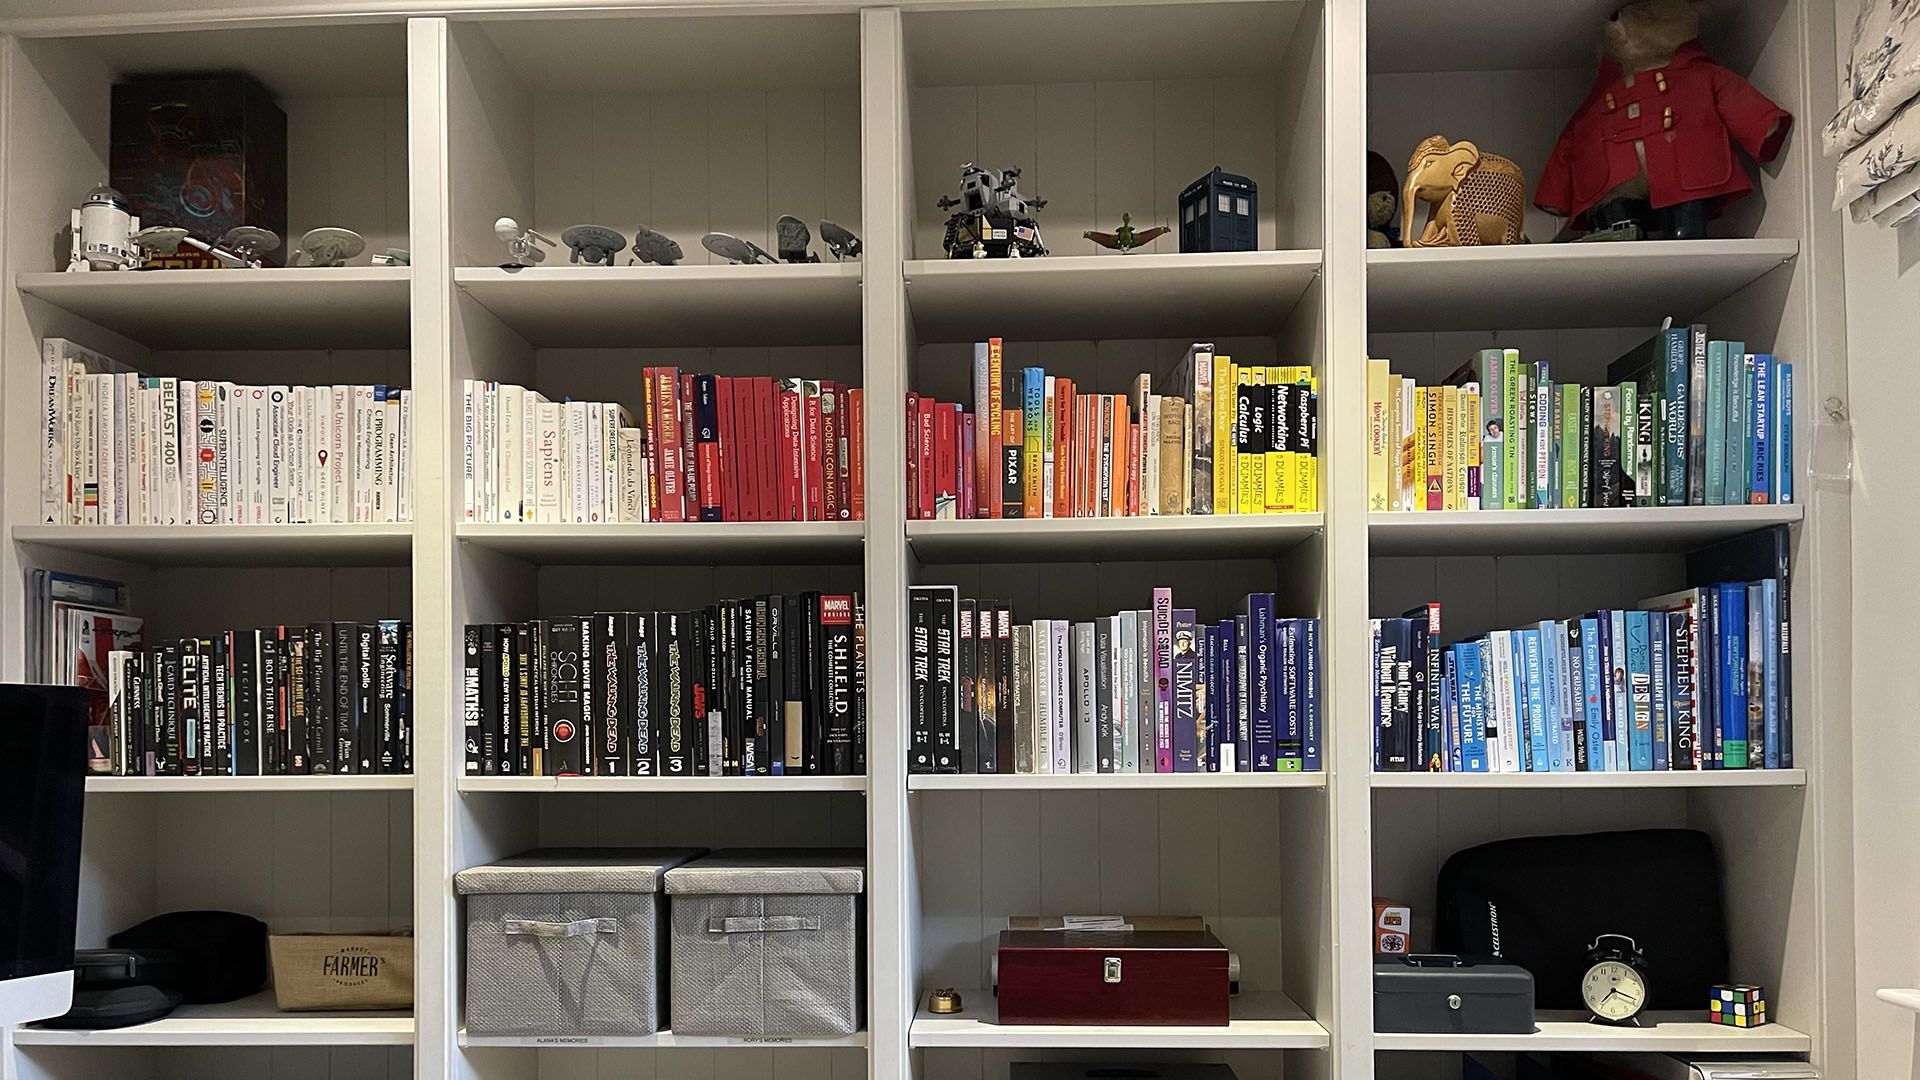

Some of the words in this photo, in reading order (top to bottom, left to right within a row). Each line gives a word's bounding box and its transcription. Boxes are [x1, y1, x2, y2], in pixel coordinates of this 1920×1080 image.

[163, 382, 174, 437] BELFAST
[1239, 396, 1250, 443] Calculus
[1254, 407, 1264, 433] Logic
[1275, 385, 1289, 450] Networking
[1298, 390, 1310, 436] Raspberry
[1639, 403, 1650, 442] KING
[1757, 403, 1765, 439] STARTUP
[335, 412, 343, 448] Unicorn
[1301, 438, 1310, 448] Pi
[165, 441, 175, 465] 400
[219, 429, 227, 507] SUPERINTELLIGENCE
[334, 452, 343, 484] Project
[539, 431, 556, 486] Sapiens
[1008, 450, 1017, 484] PIXAR
[628, 479, 634, 488] da
[1240, 462, 1249, 504] DUMMIES
[1253, 462, 1262, 505] DUMMIES
[1275, 460, 1284, 503] DUMMIES
[1299, 461, 1309, 503] DUMMIES
[824, 600, 849, 610] MARVEL
[855, 604, 864, 629] THE
[1157, 598, 1169, 635] SUICIDE
[1430, 608, 1440, 632] MARVEL
[961, 611, 972, 638] MARVEL
[980, 611, 992, 638] MARVEL
[998, 611, 1009, 638] MARVEL
[1258, 608, 1266, 643] Lishman's
[339, 630, 347, 654] UNTIL
[360, 633, 370, 660] Digital
[606, 641, 617, 667] THE
[637, 642, 648, 668] THE
[669, 640, 680, 666] THE
[1157, 638, 1169, 669] SQUAD
[1586, 644, 1595, 671] Family
[216, 665, 224, 681] TECH
[361, 662, 370, 688] Apollo
[834, 635, 848, 717] S.H.I.E.L.D.
[856, 636, 864, 693] PLANETS
[1258, 645, 1266, 674] Organic
[1381, 646, 1396, 684] Without
[1398, 660, 1412, 681] Tom
[1430, 649, 1439, 701] INFINITY
[1528, 637, 1540, 684] REINVENTING
[1572, 656, 1580, 668] NO
[1676, 629, 1689, 696] STEPHEN
[167, 665, 175, 690] CARD
[183, 655, 196, 709] ELITE
[386, 654, 396, 699] Software
[558, 651, 577, 702] SCI-FI
[607, 668, 617, 718] WALKING
[670, 667, 680, 717] WALKING
[1176, 662, 1193, 719] NIMITZ
[1461, 682, 1471, 703] THE
[216, 683, 224, 708] TRENDS
[266, 686, 274, 711] THEY
[340, 696, 348, 709] OF
[465, 677, 478, 720] MATHS
[638, 669, 648, 719] WALKING
[694, 683, 704, 719] JAWS
[1258, 676, 1267, 713] Psychiatry
[1381, 686, 1396, 728] Remorse
[1396, 682, 1412, 713] Clancy
[1532, 687, 1541, 702] THE
[167, 692, 176, 739] TECHNIQUE
[217, 709, 225, 717] IN
[340, 712, 348, 732] TIME
[1100, 704, 1108, 723] Andy
[1431, 704, 1440, 730] WAR
[1462, 705, 1472, 744] FUTURE
[1532, 704, 1543, 736] PRODUCT
[1590, 708, 1598, 729] Emily
[1679, 710, 1690, 748] KING
[217, 719, 226, 749] PRACTICE
[607, 718, 617, 752] DEAD
[638, 720, 648, 754] DEAD
[670, 718, 681, 752] DEAD
[1040, 745, 1047, 754] PI
[637, 761, 650, 774] 2
[669, 759, 682, 772] 3
[1490, 904, 1500, 950] CELESTRON
